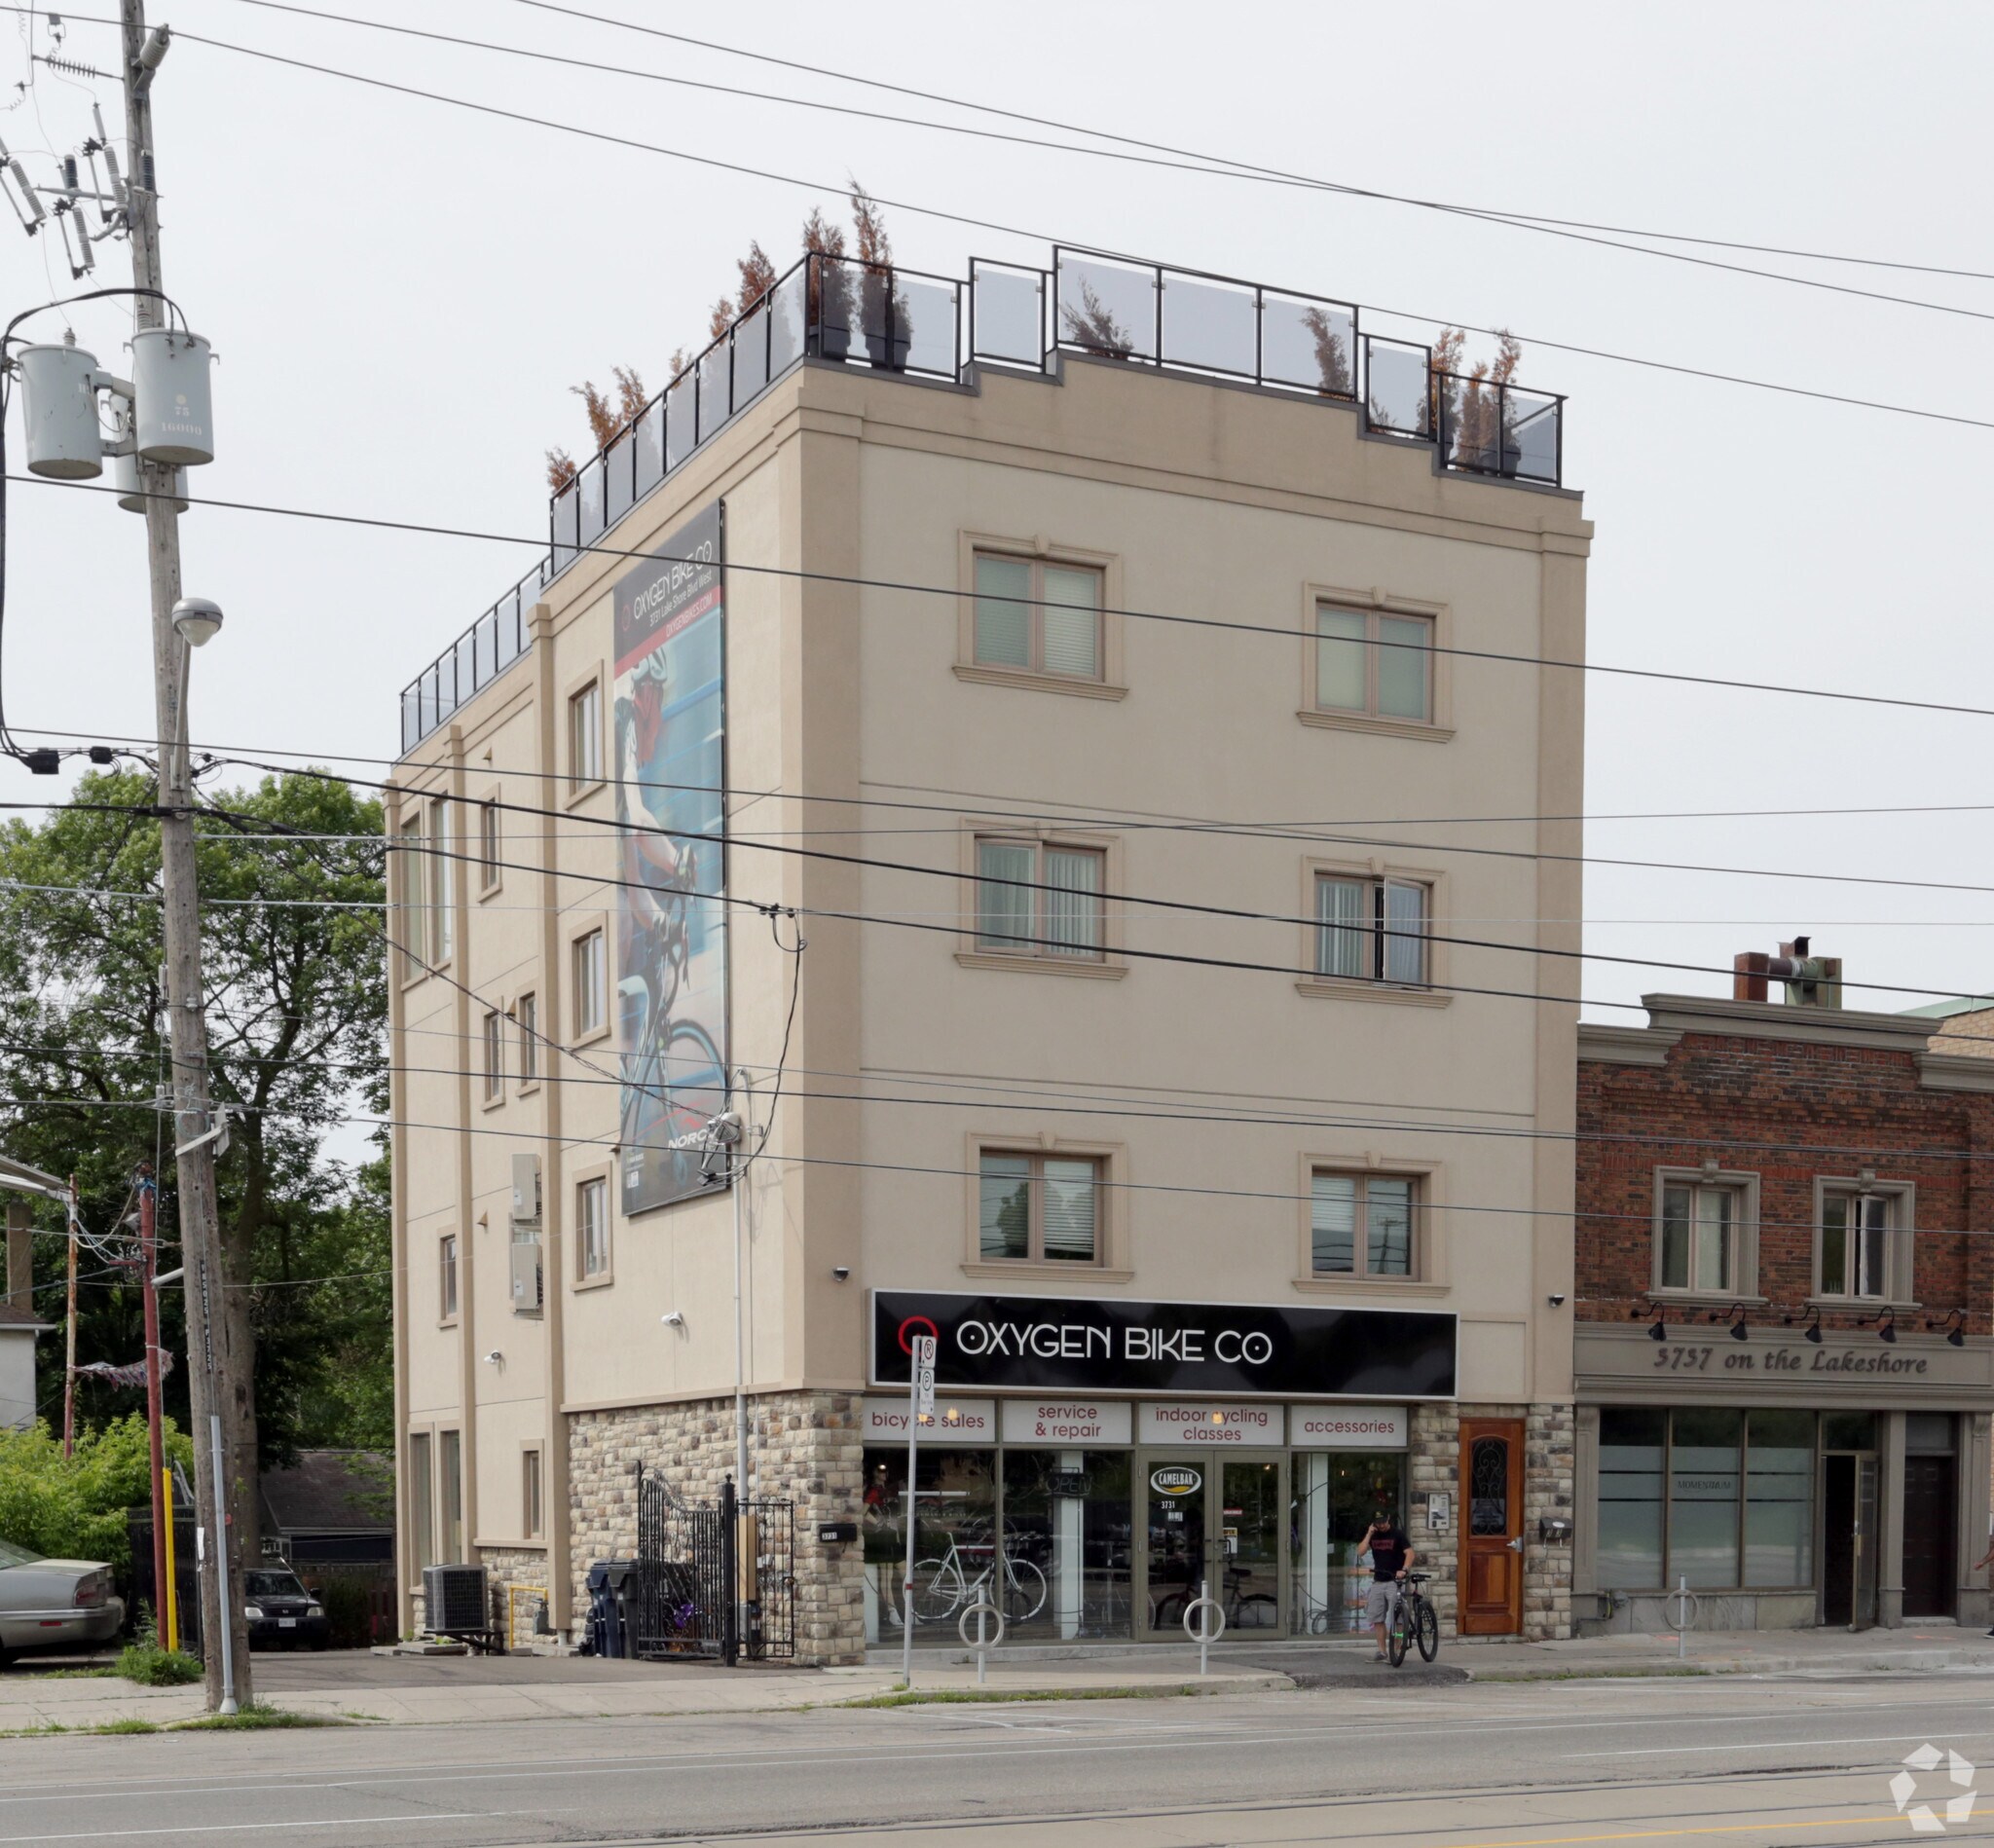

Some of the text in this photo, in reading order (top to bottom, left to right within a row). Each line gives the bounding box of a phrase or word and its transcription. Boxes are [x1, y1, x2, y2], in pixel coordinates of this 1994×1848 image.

[174, 406, 190, 416] 75
[634, 540, 712, 619] OXYGEN BIKE CO
[661, 602, 673, 617] Lake
[673, 591, 686, 608] Shore
[686, 579, 698, 598] Blvd
[698, 570, 713, 587] West
[668, 1128, 710, 1151] NORC
[956, 1320, 1274, 1365] OXYGEN BIKE CO
[1654, 1347, 1928, 1374] 3737 on the Lakeshore
[871, 1412, 985, 1430] bicye sales
[1037, 1405, 1097, 1421] service
[1156, 1407, 1206, 1422] indoor
[1035, 1423, 1101, 1440] & repair
[1183, 1426, 1241, 1441] classes
[1304, 1420, 1395, 1433] accessories
[1045, 1476, 1091, 1493] OPEN
[1159, 1472, 1194, 1486] CAMELBAK
[1161, 1500, 1175, 1509] 3731
